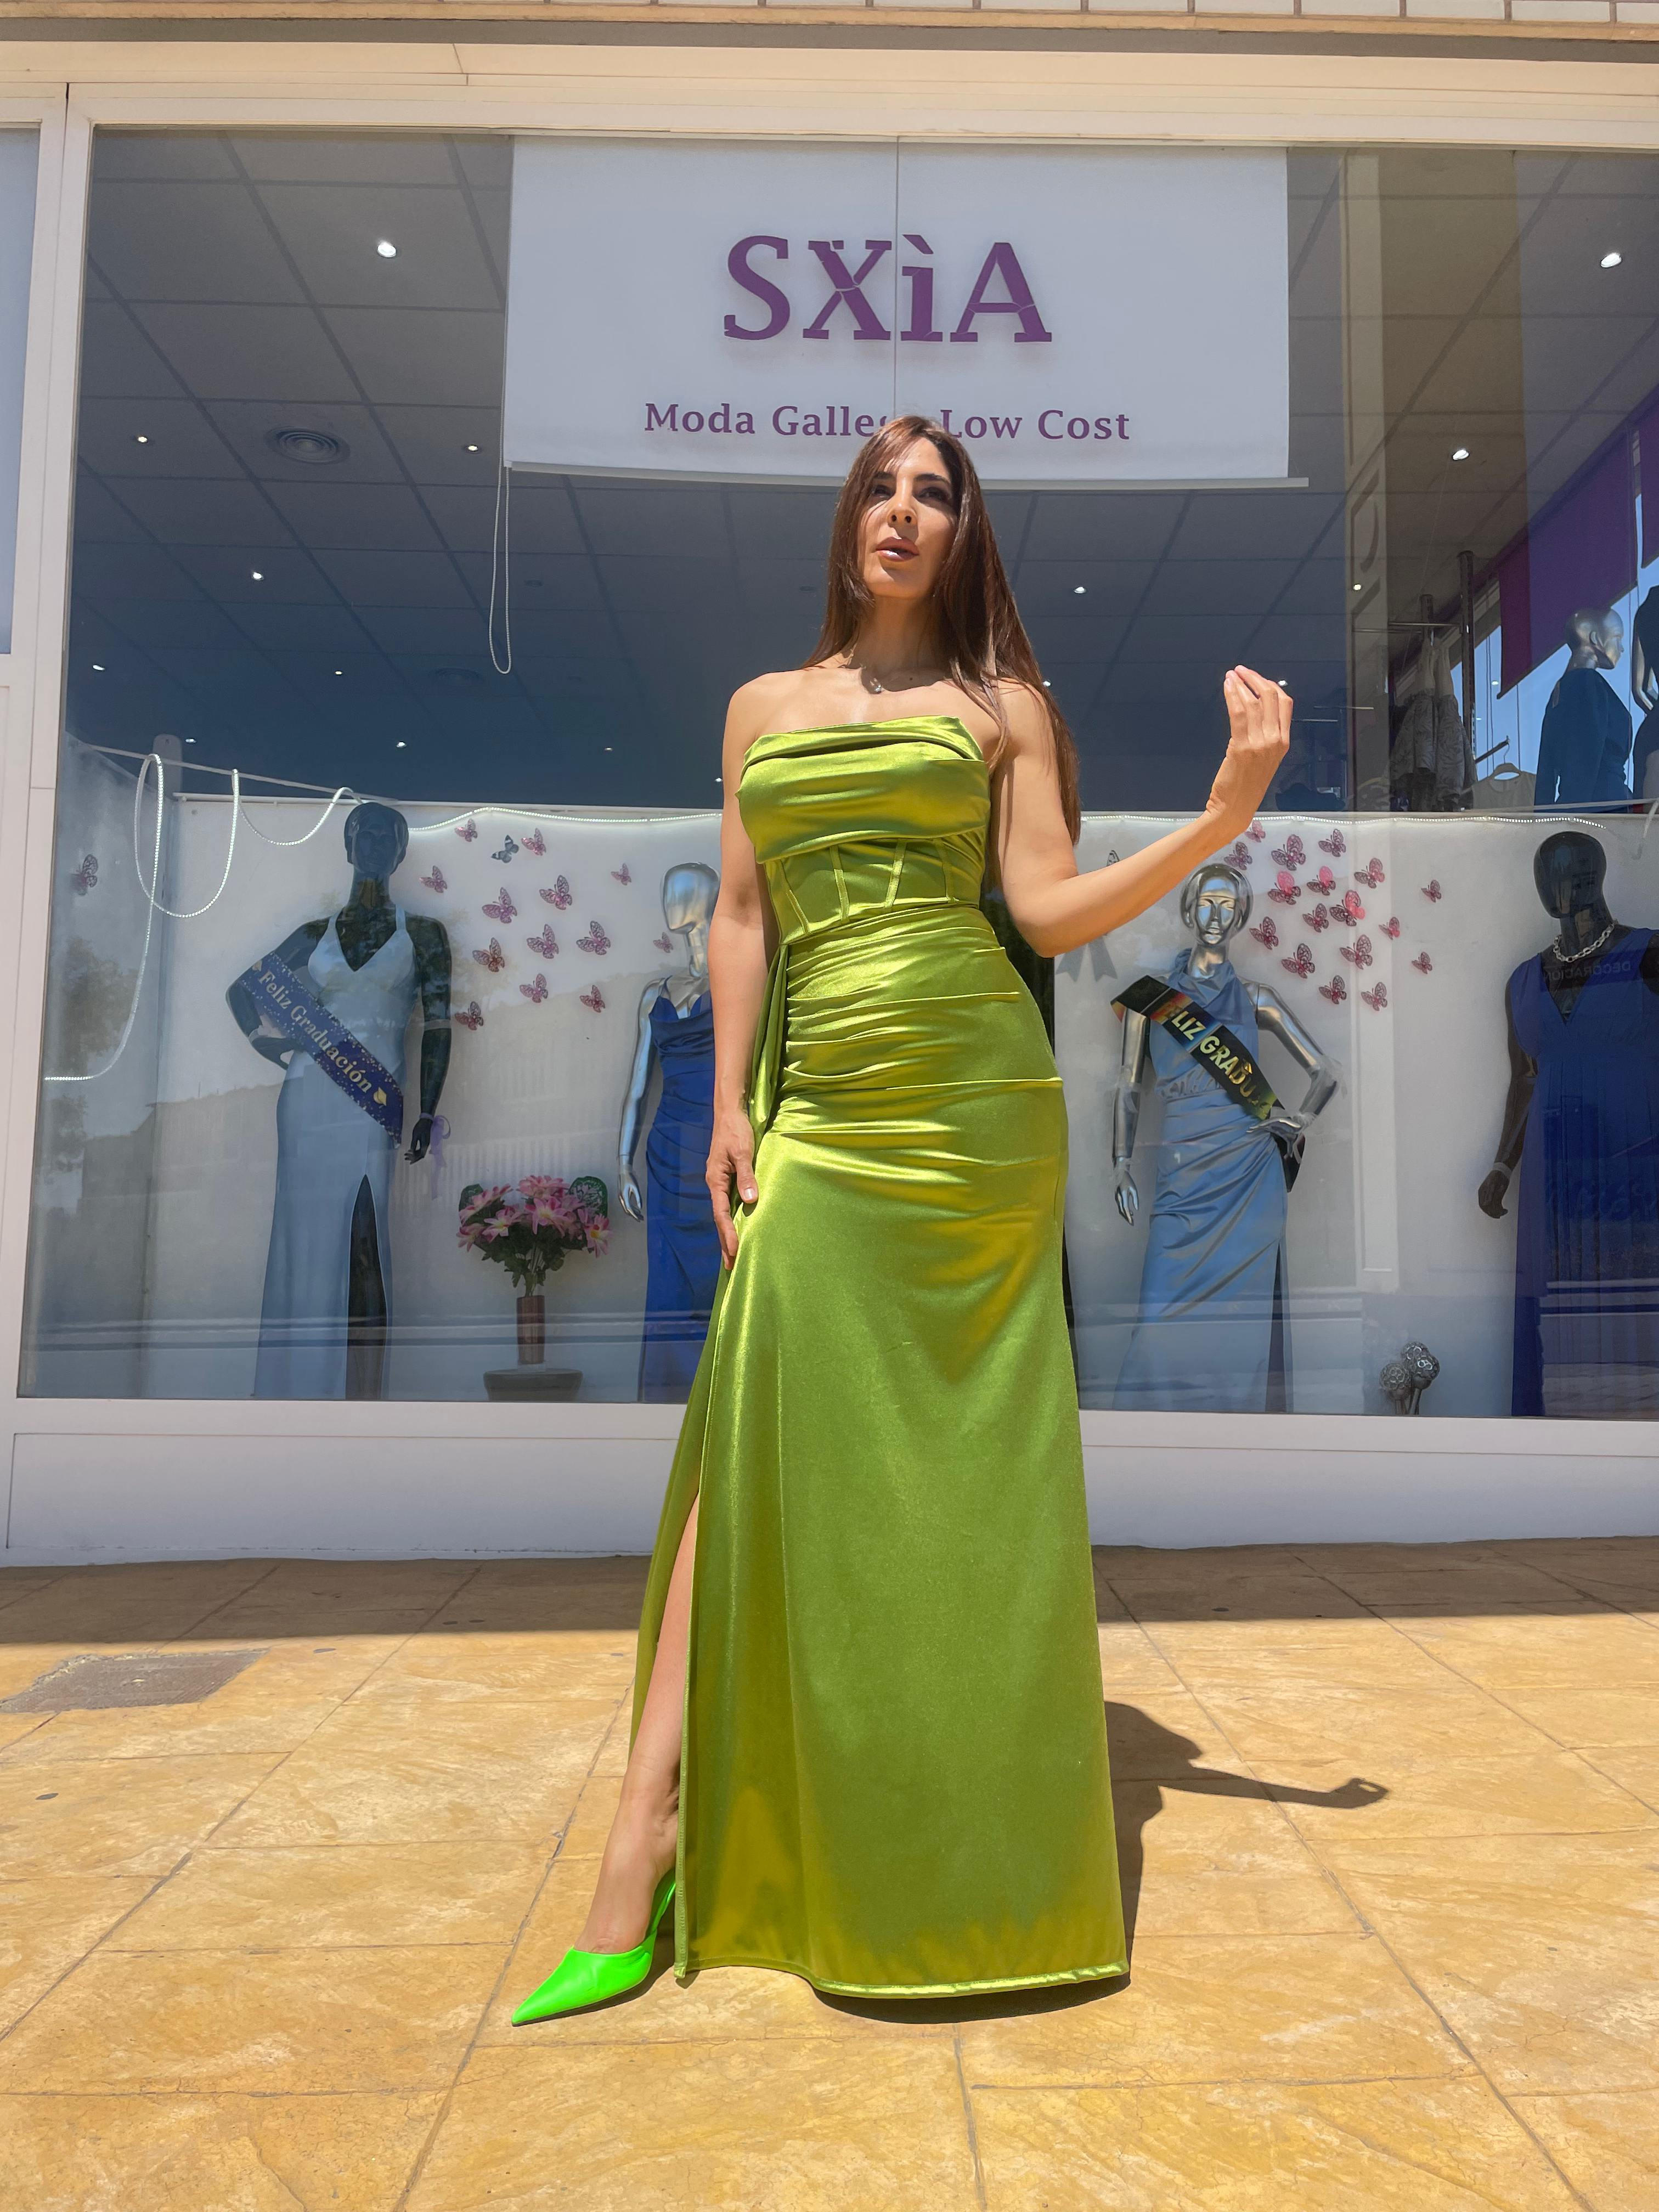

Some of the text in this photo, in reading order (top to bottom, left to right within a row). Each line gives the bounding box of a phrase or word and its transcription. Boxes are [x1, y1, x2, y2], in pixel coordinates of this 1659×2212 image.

[644, 403, 1130, 440] Moda Galle Low Cost
[258, 970, 372, 1093] Feliz Graduación
[1167, 1008, 1259, 1104] LIZ GRADU
